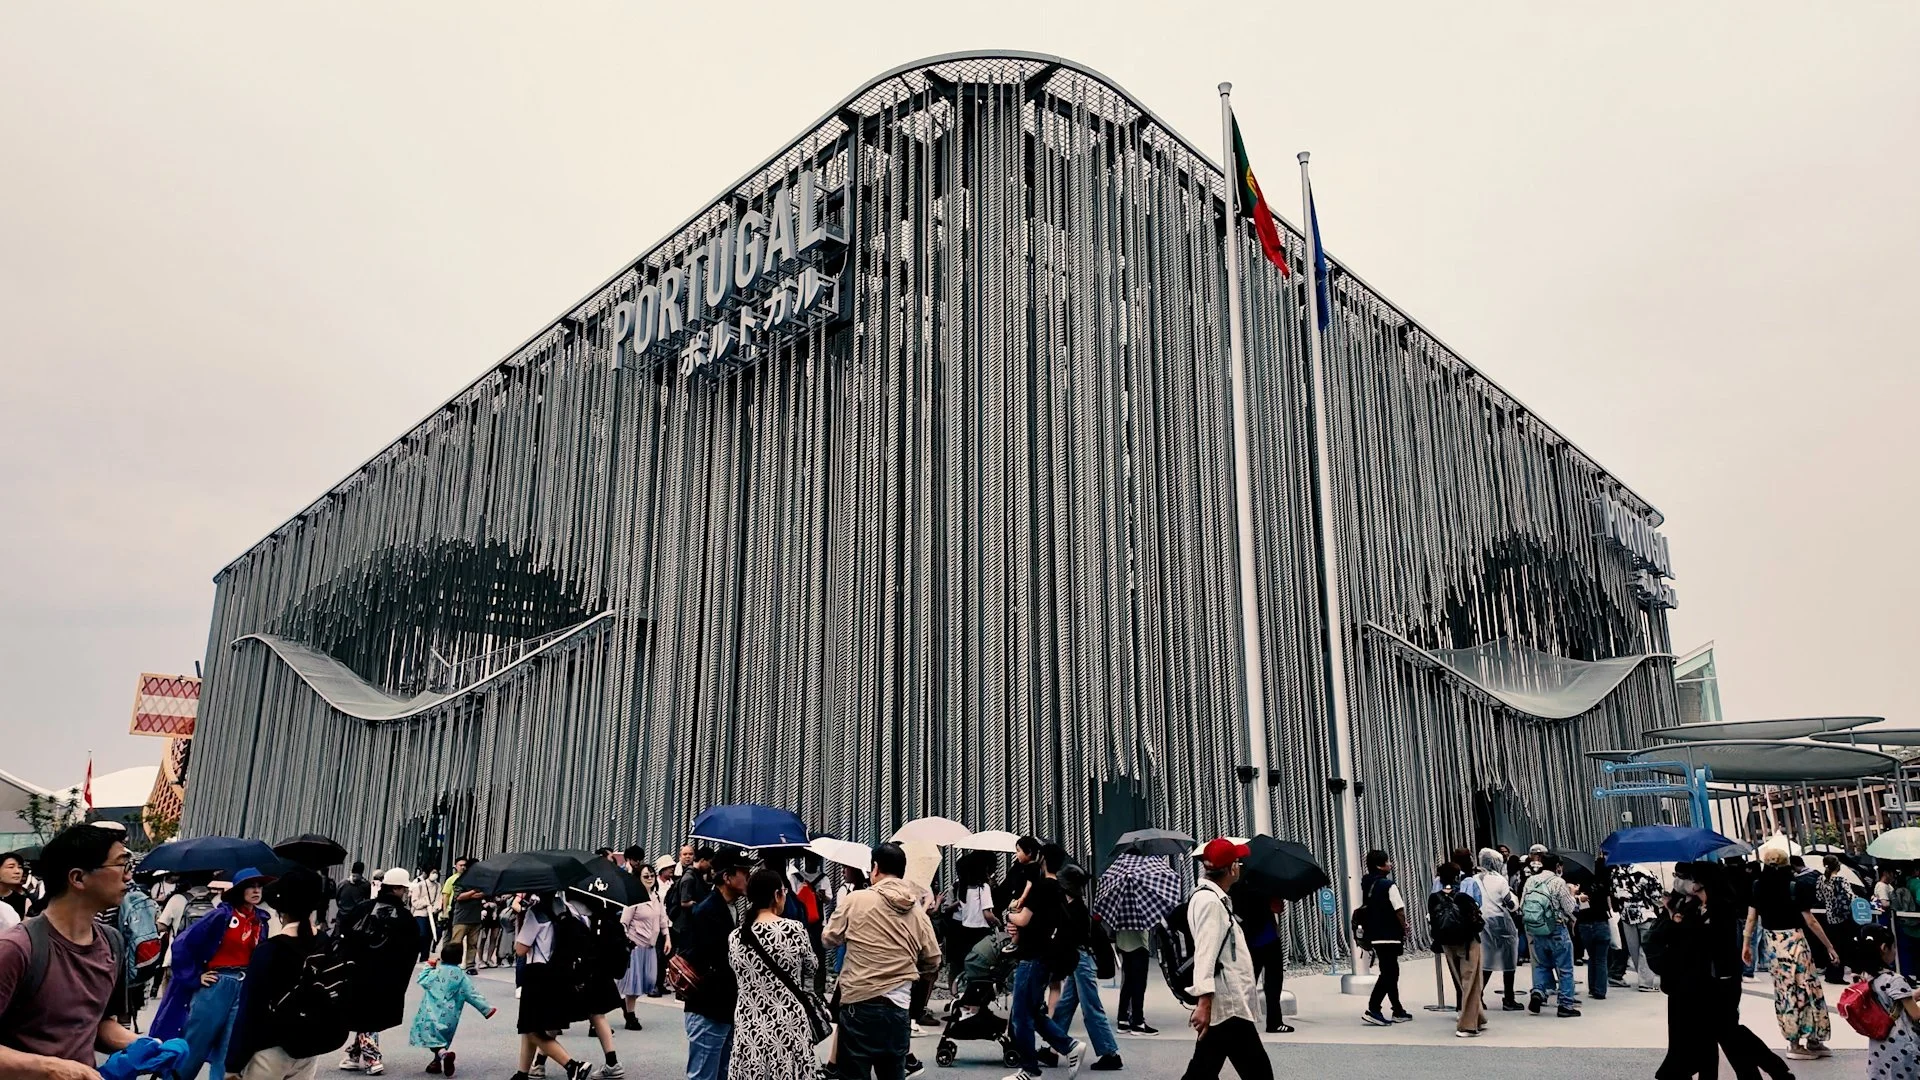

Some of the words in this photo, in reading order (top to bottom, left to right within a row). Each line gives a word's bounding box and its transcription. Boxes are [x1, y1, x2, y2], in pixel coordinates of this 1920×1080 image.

[611, 170, 827, 371] PORTUGAL
[681, 267, 827, 377] ポルトガル
